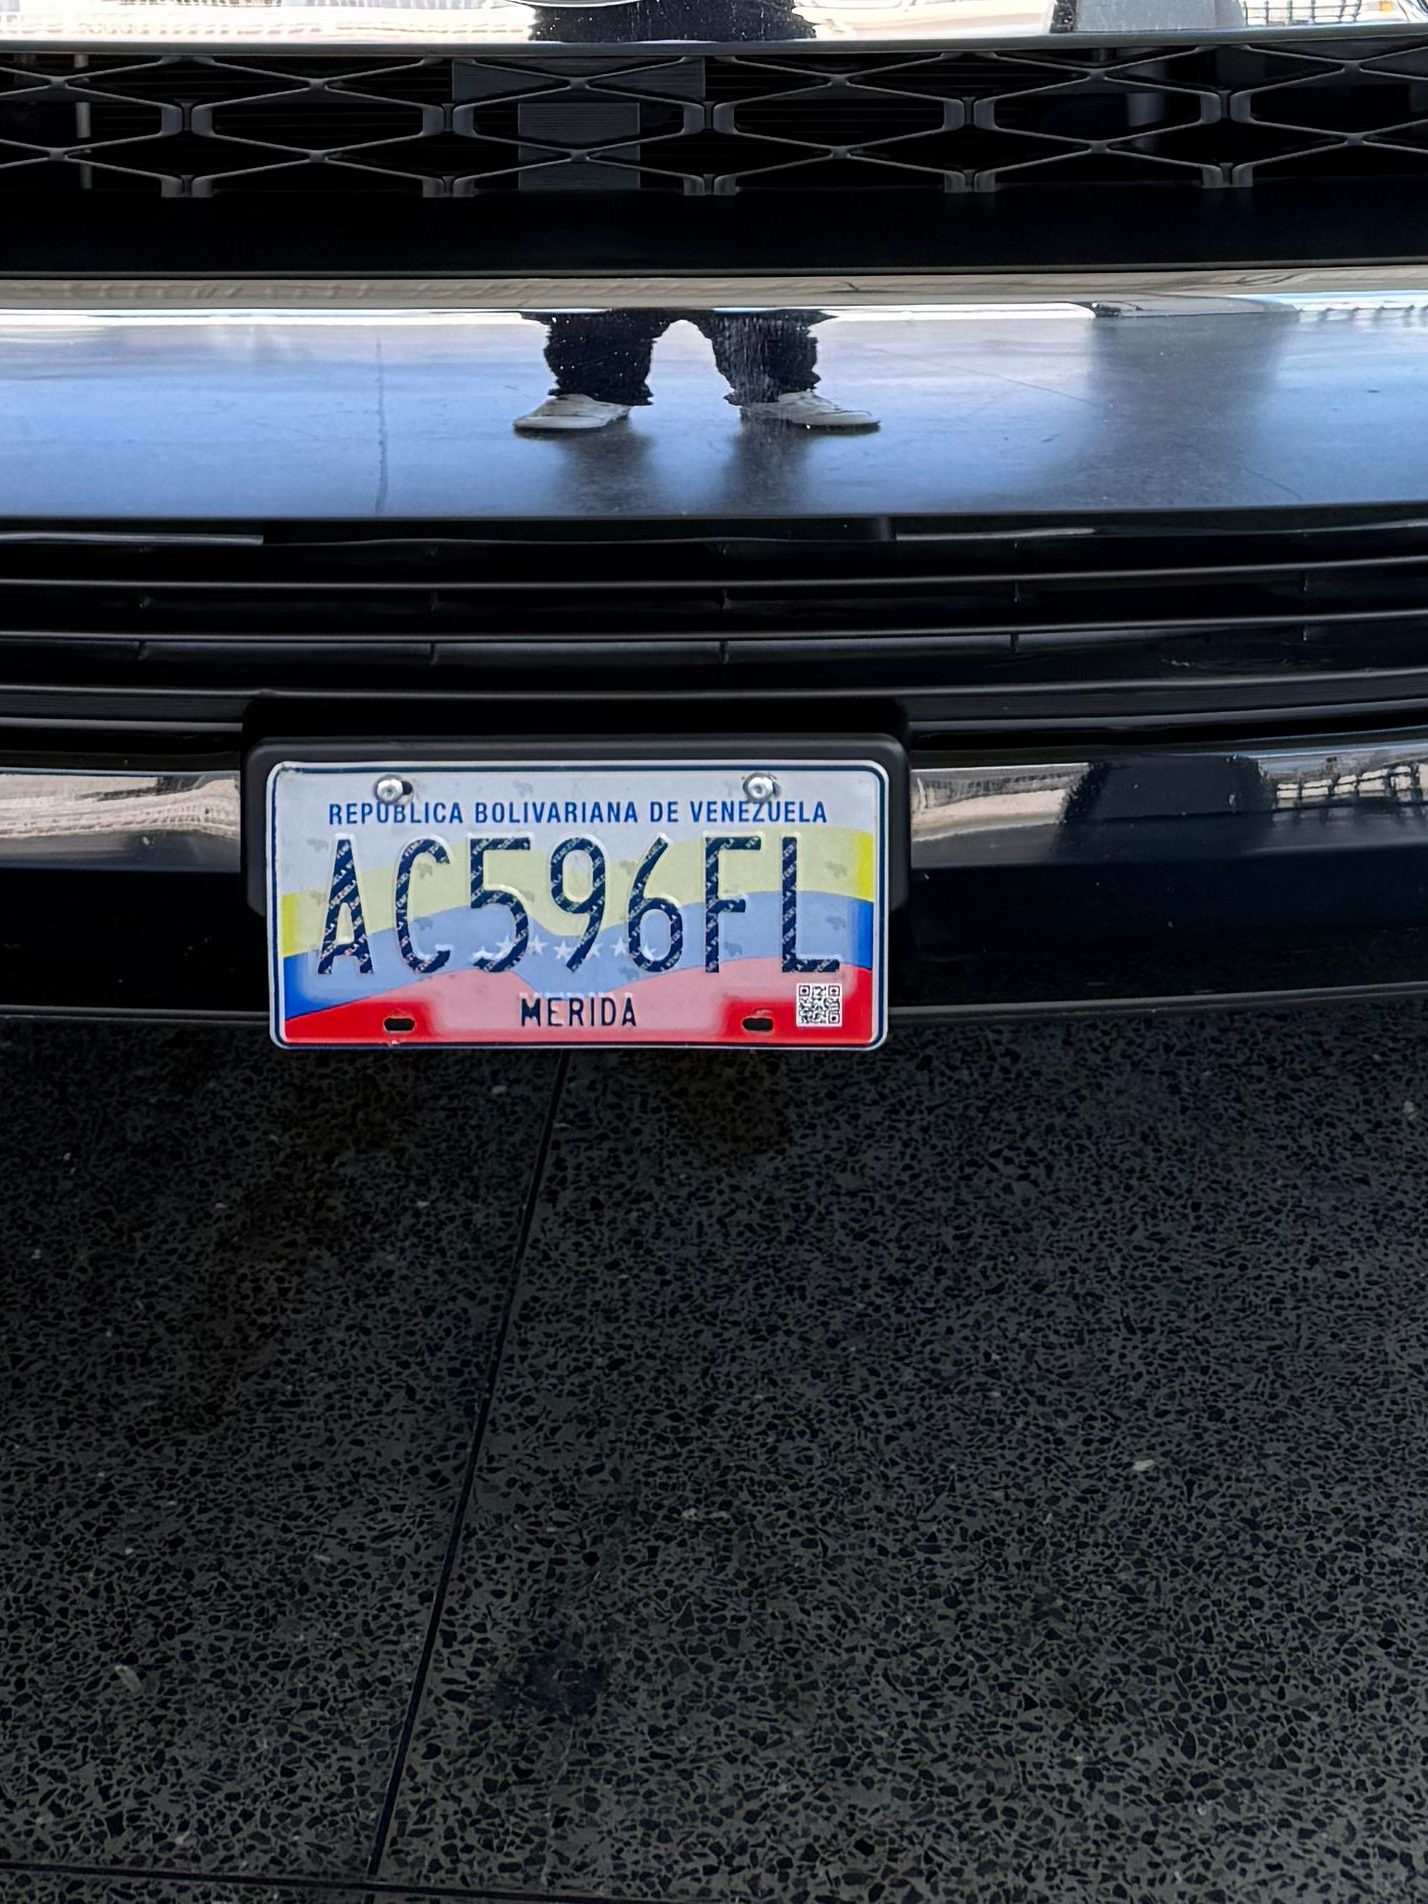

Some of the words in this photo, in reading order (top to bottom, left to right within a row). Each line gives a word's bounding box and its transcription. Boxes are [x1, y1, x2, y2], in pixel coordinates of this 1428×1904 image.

[474, 800, 639, 825] BOLIVARIANA
[649, 800, 679, 824] DE
[689, 799, 828, 824] VENEZUELA
[317, 835, 842, 976] AC596FL
[520, 996, 638, 1028] MERIDA
